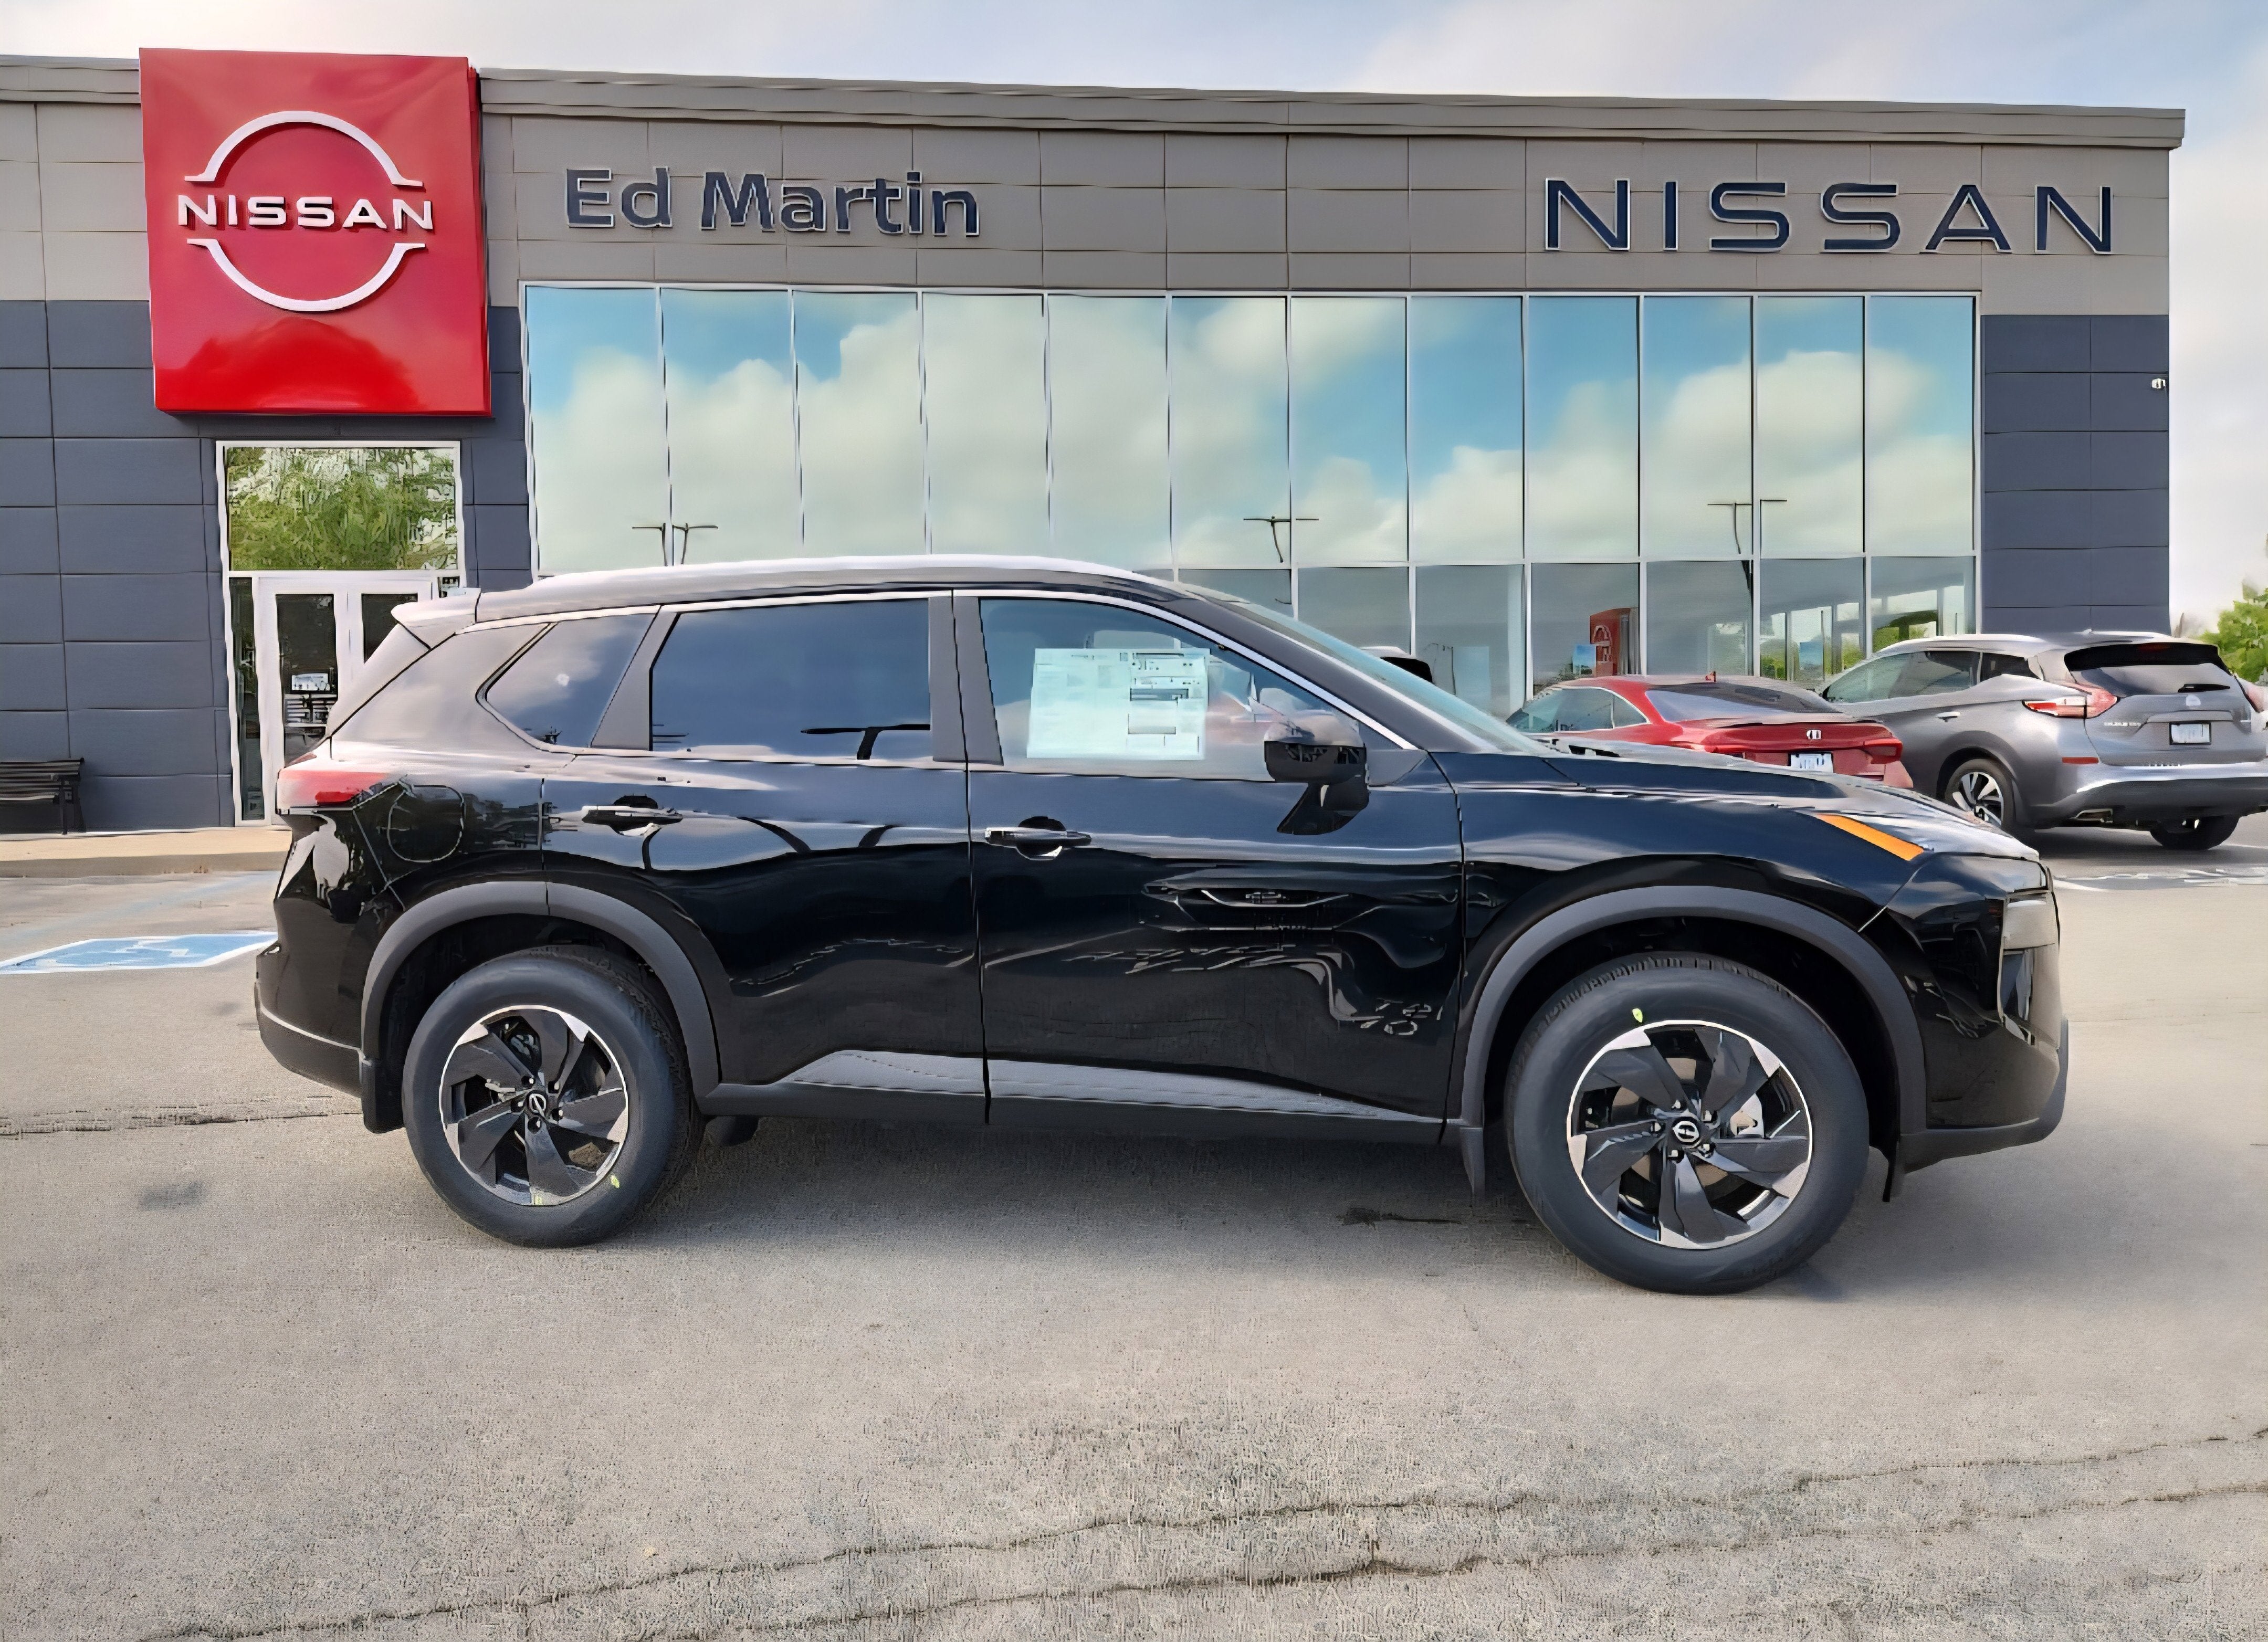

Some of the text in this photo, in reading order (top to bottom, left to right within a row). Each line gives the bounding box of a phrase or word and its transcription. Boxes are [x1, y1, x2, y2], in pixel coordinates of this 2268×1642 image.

[177, 194, 434, 230] NISSAN
[565, 165, 980, 237] Ed Martin
[1545, 177, 2113, 255] NISSAN
